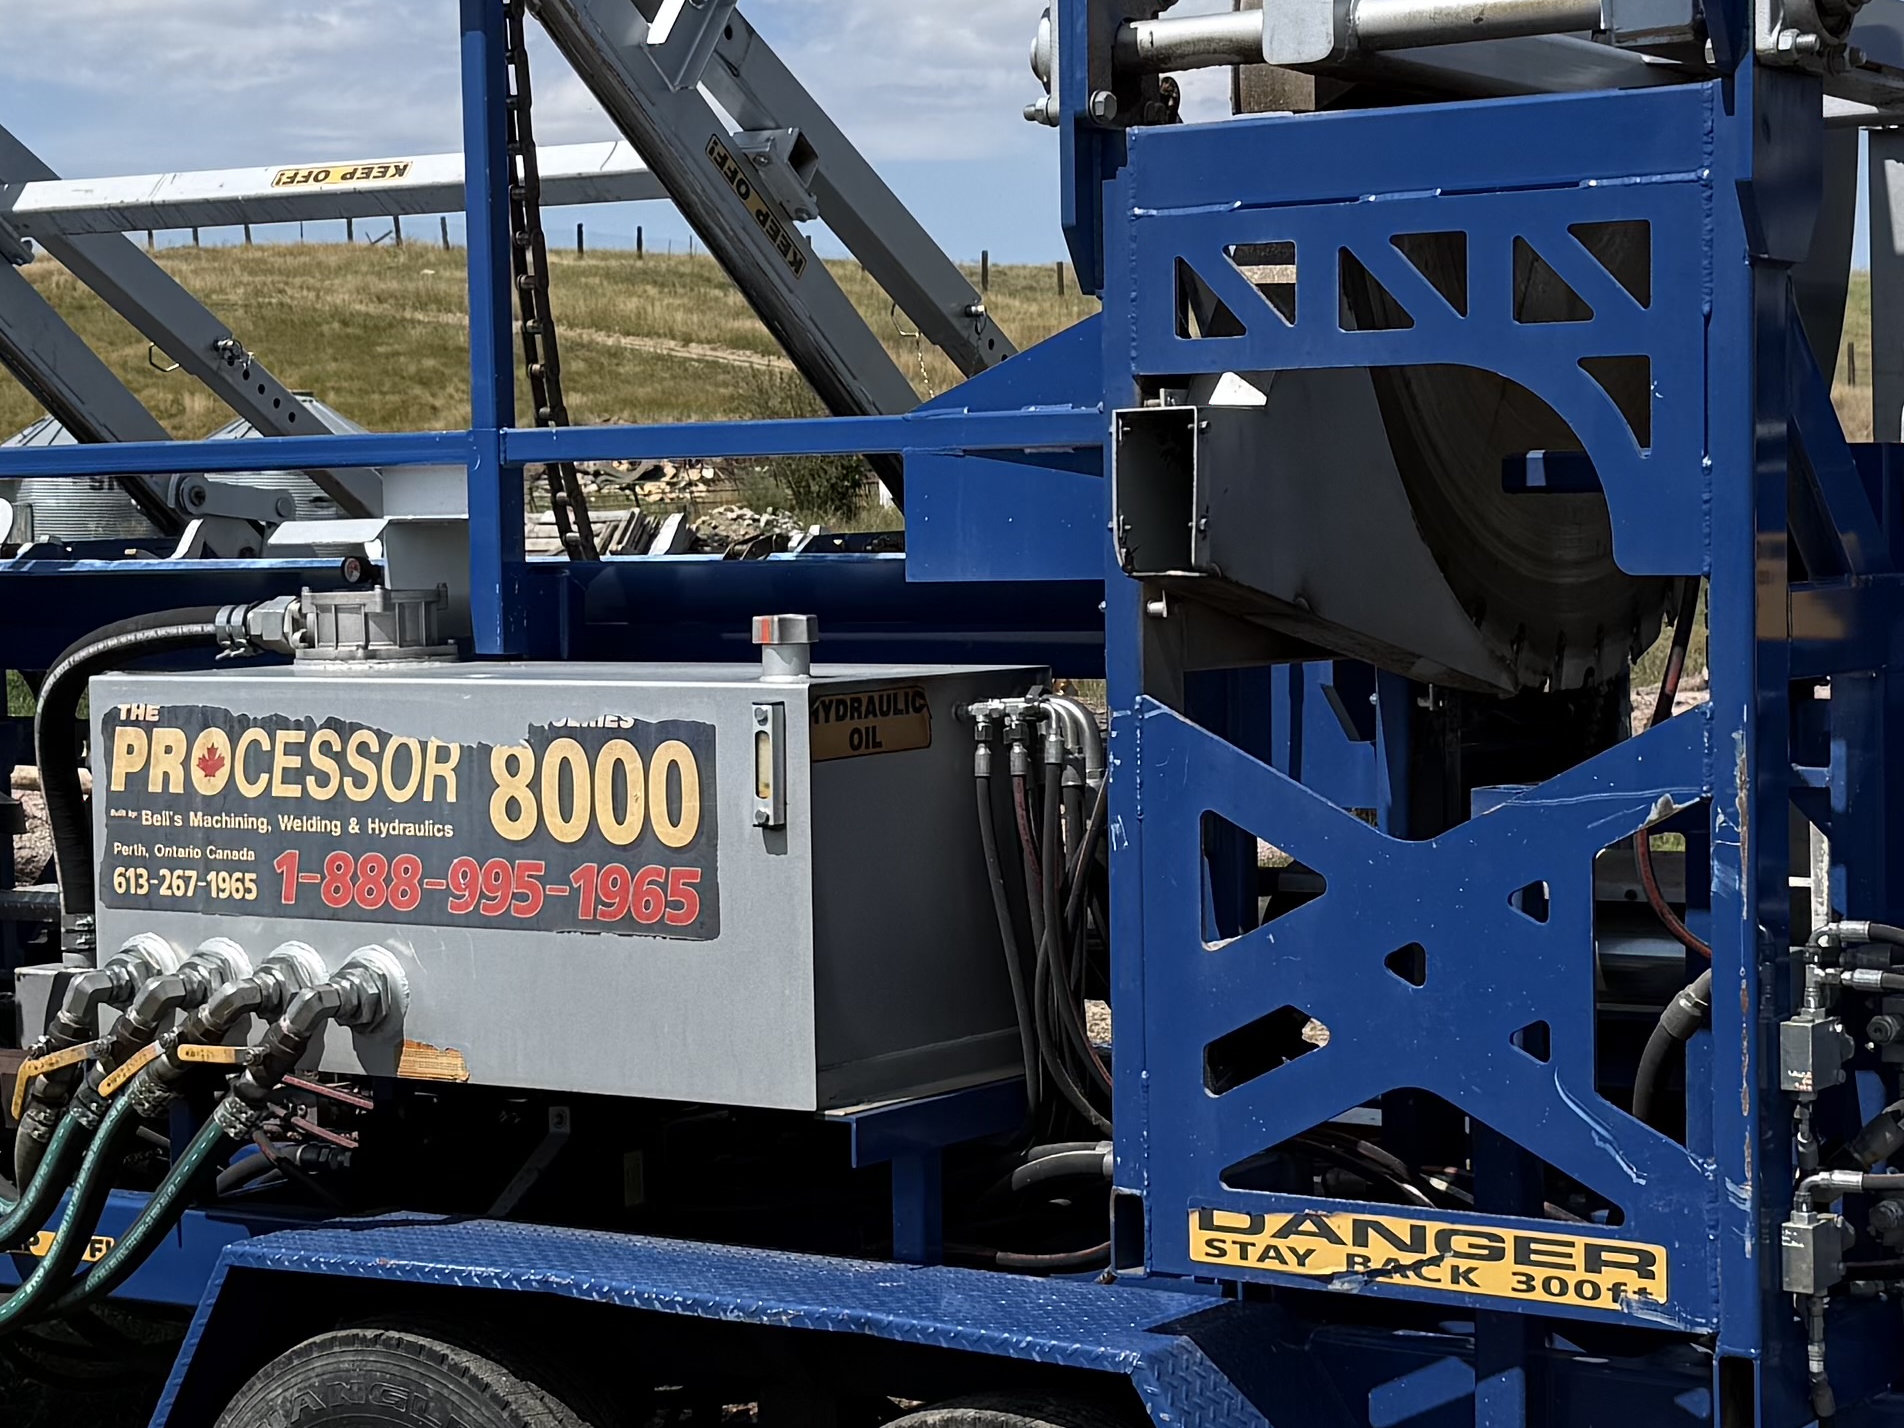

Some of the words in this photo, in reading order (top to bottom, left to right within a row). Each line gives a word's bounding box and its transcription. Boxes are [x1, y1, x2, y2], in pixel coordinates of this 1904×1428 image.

[275, 169, 331, 186] OFF!
[340, 163, 409, 181] KEEP
[707, 138, 751, 201] OFF!
[756, 208, 804, 275] KEEP
[118, 703, 160, 722] THE
[848, 725, 883, 752] OIL
[110, 725, 461, 803] PROCESSOR
[489, 737, 701, 848] 8000
[141, 809, 183, 827] Bell's
[189, 811, 272, 834] Machining,
[278, 814, 342, 837] Welding
[348, 817, 360, 834] &
[367, 817, 454, 838] Hydraulics
[113, 842, 149, 859] Perth,
[154, 843, 202, 859] Ontario
[206, 845, 256, 861] Canada
[113, 866, 258, 901] 613-267-1965
[273, 849, 701, 926] 1-888-995-1965
[1198, 1209, 1657, 1281] DANGER
[1204, 1238, 1316, 1268] STAY
[1346, 1252, 1481, 1288] BACK
